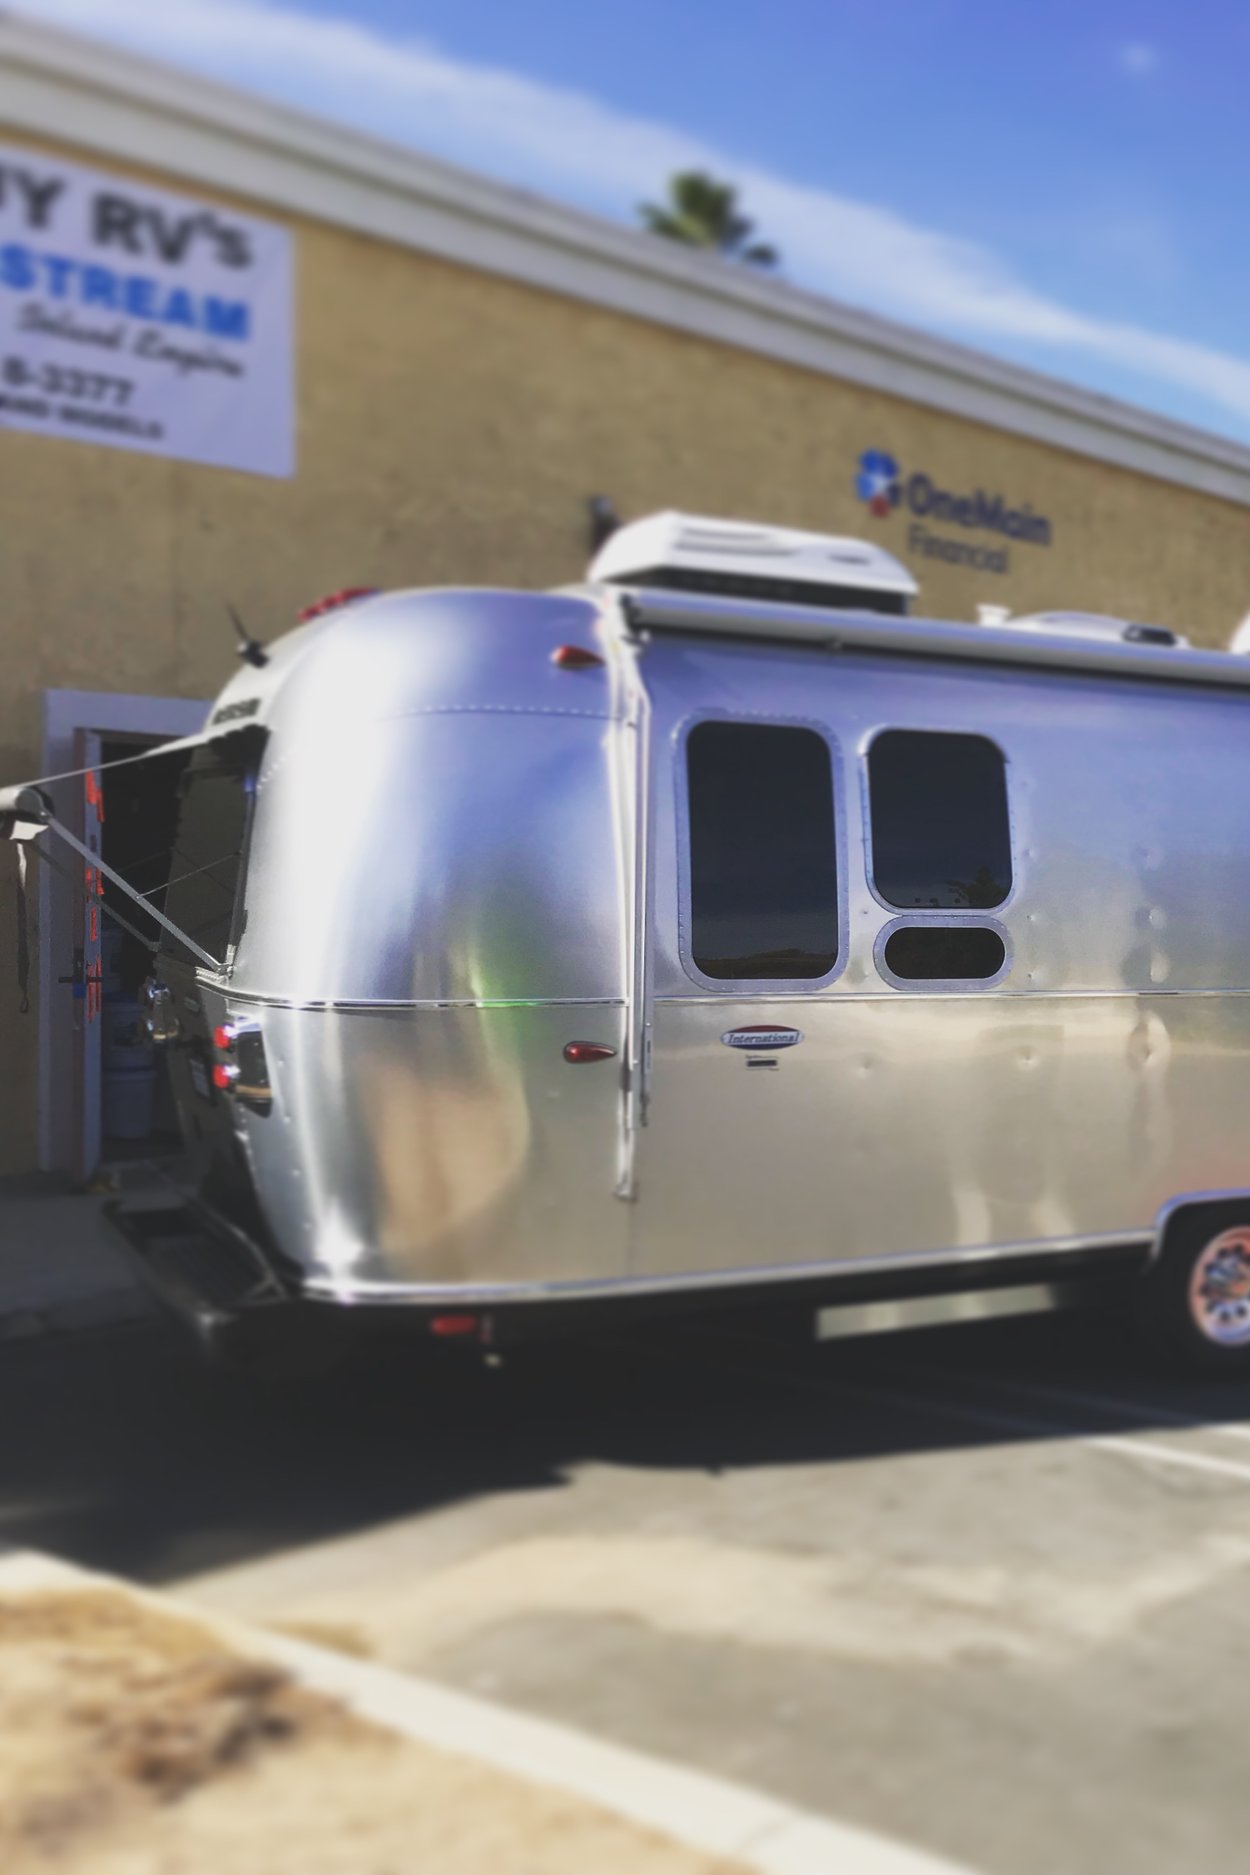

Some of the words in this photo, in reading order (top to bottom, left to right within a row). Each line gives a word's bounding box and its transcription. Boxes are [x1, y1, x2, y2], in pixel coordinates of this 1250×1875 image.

[91, 189, 252, 271] RV's
[0, 242, 251, 343] STREAM
[906, 472, 1053, 547] OneMain
[908, 522, 1009, 575] Financial
[727, 1031, 801, 1044] International
